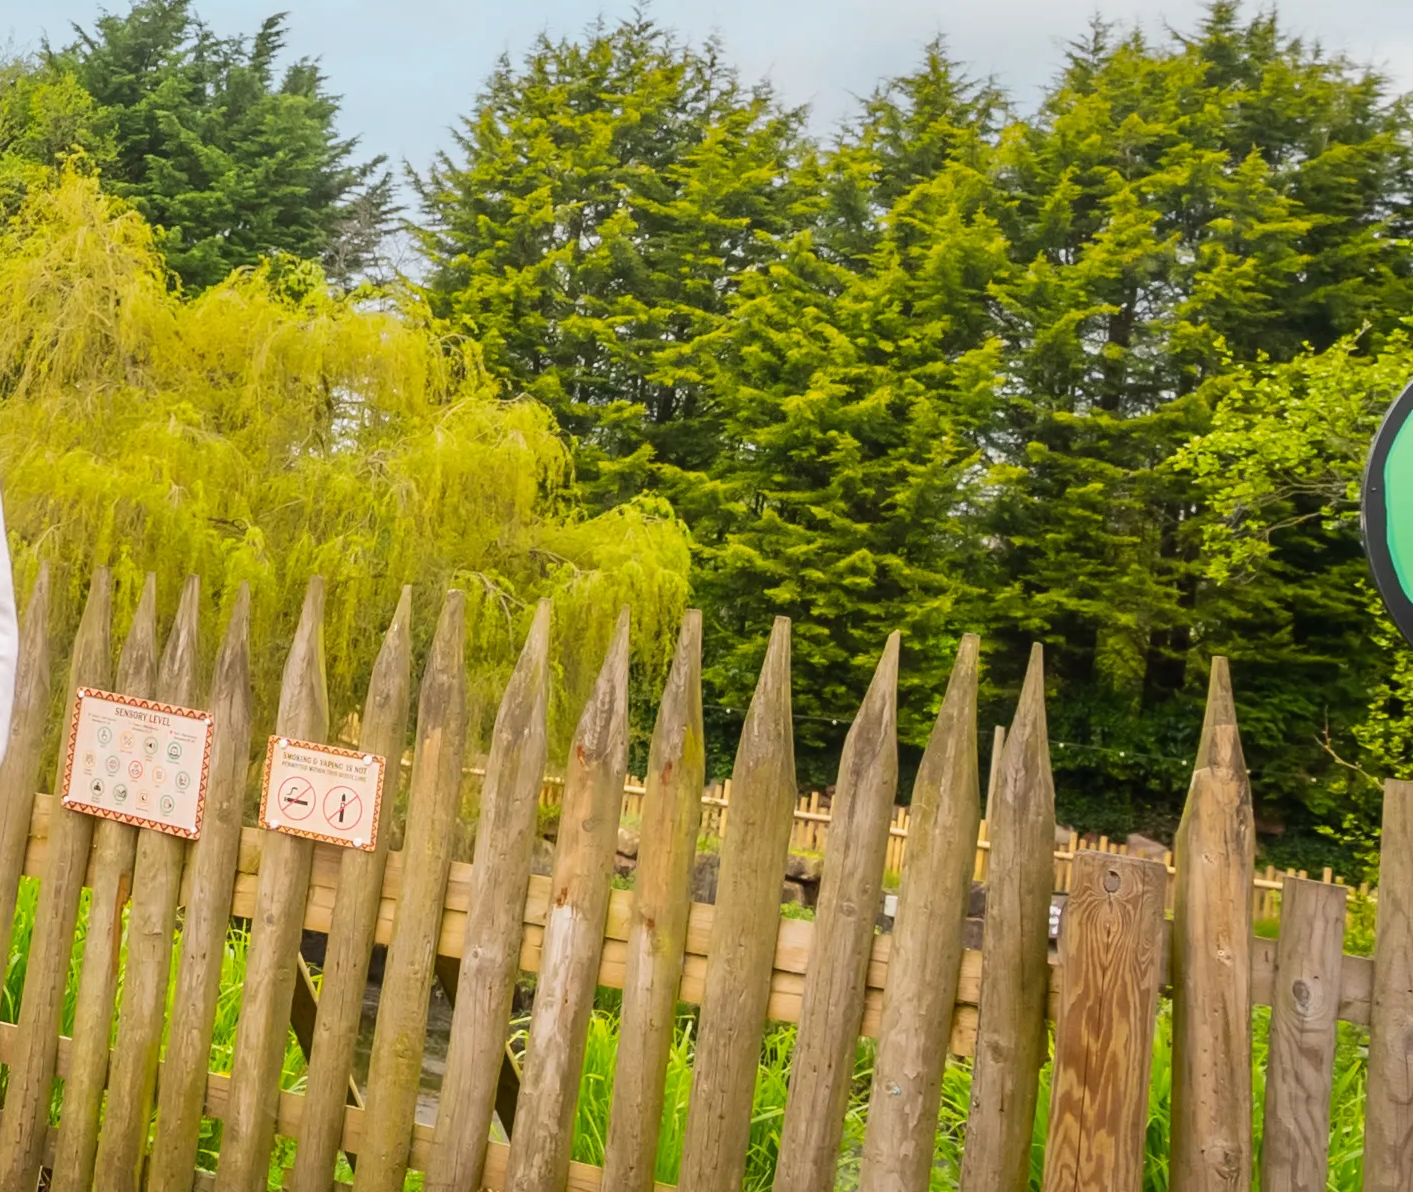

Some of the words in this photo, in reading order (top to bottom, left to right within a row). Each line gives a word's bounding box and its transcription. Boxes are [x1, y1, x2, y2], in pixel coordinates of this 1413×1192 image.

[114, 707, 148, 723] SENSORY
[149, 714, 171, 727] LEVEL
[283, 752, 311, 764] SMOKING
[319, 759, 344, 769] VAPING
[346, 764, 353, 772] IS
[354, 766, 368, 775] NOT
